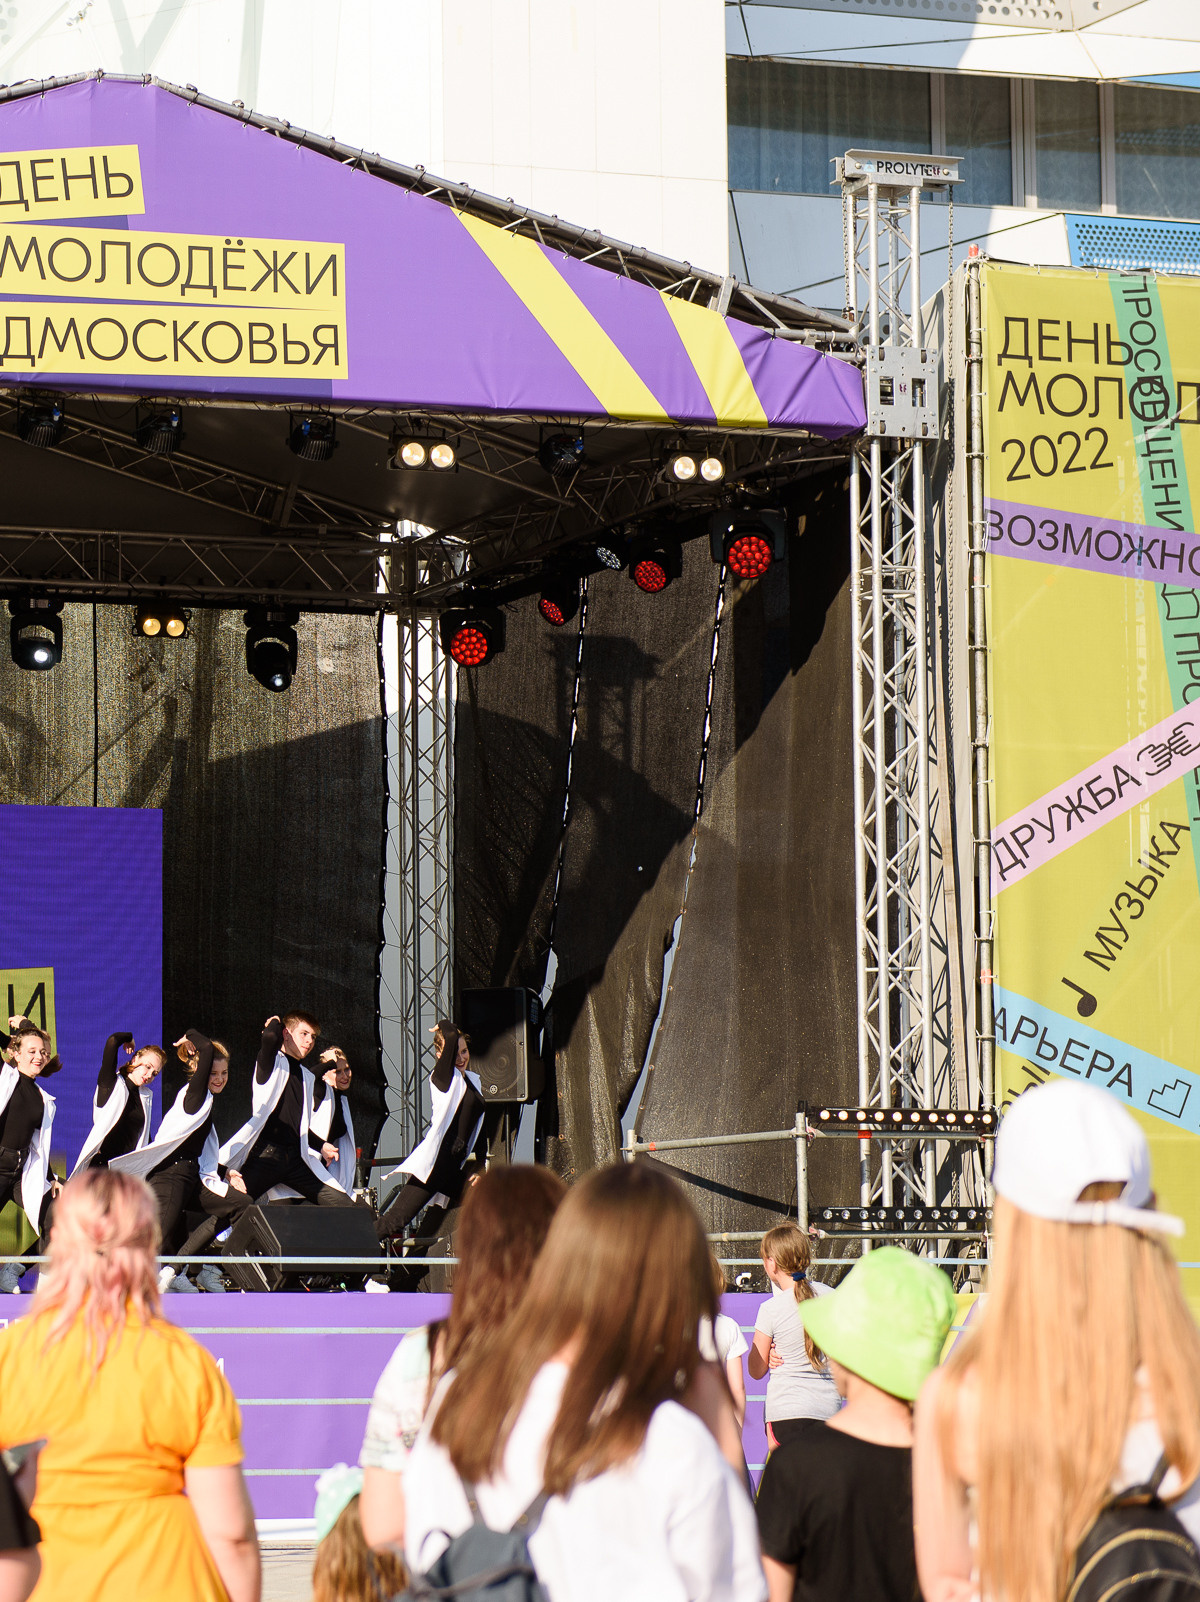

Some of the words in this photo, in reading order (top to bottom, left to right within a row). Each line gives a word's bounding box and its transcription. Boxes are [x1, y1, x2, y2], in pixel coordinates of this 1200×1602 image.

[876, 160, 933, 177] PROLYTE
[997, 316, 1134, 369] ДЕНЬ
[1119, 273, 1184, 531] ПРОСВЕЩЕНИ
[1000, 426, 1114, 483] 2022
[991, 764, 1143, 882] ДРУЖБА
[1082, 821, 1191, 972] МУЗЫКА
